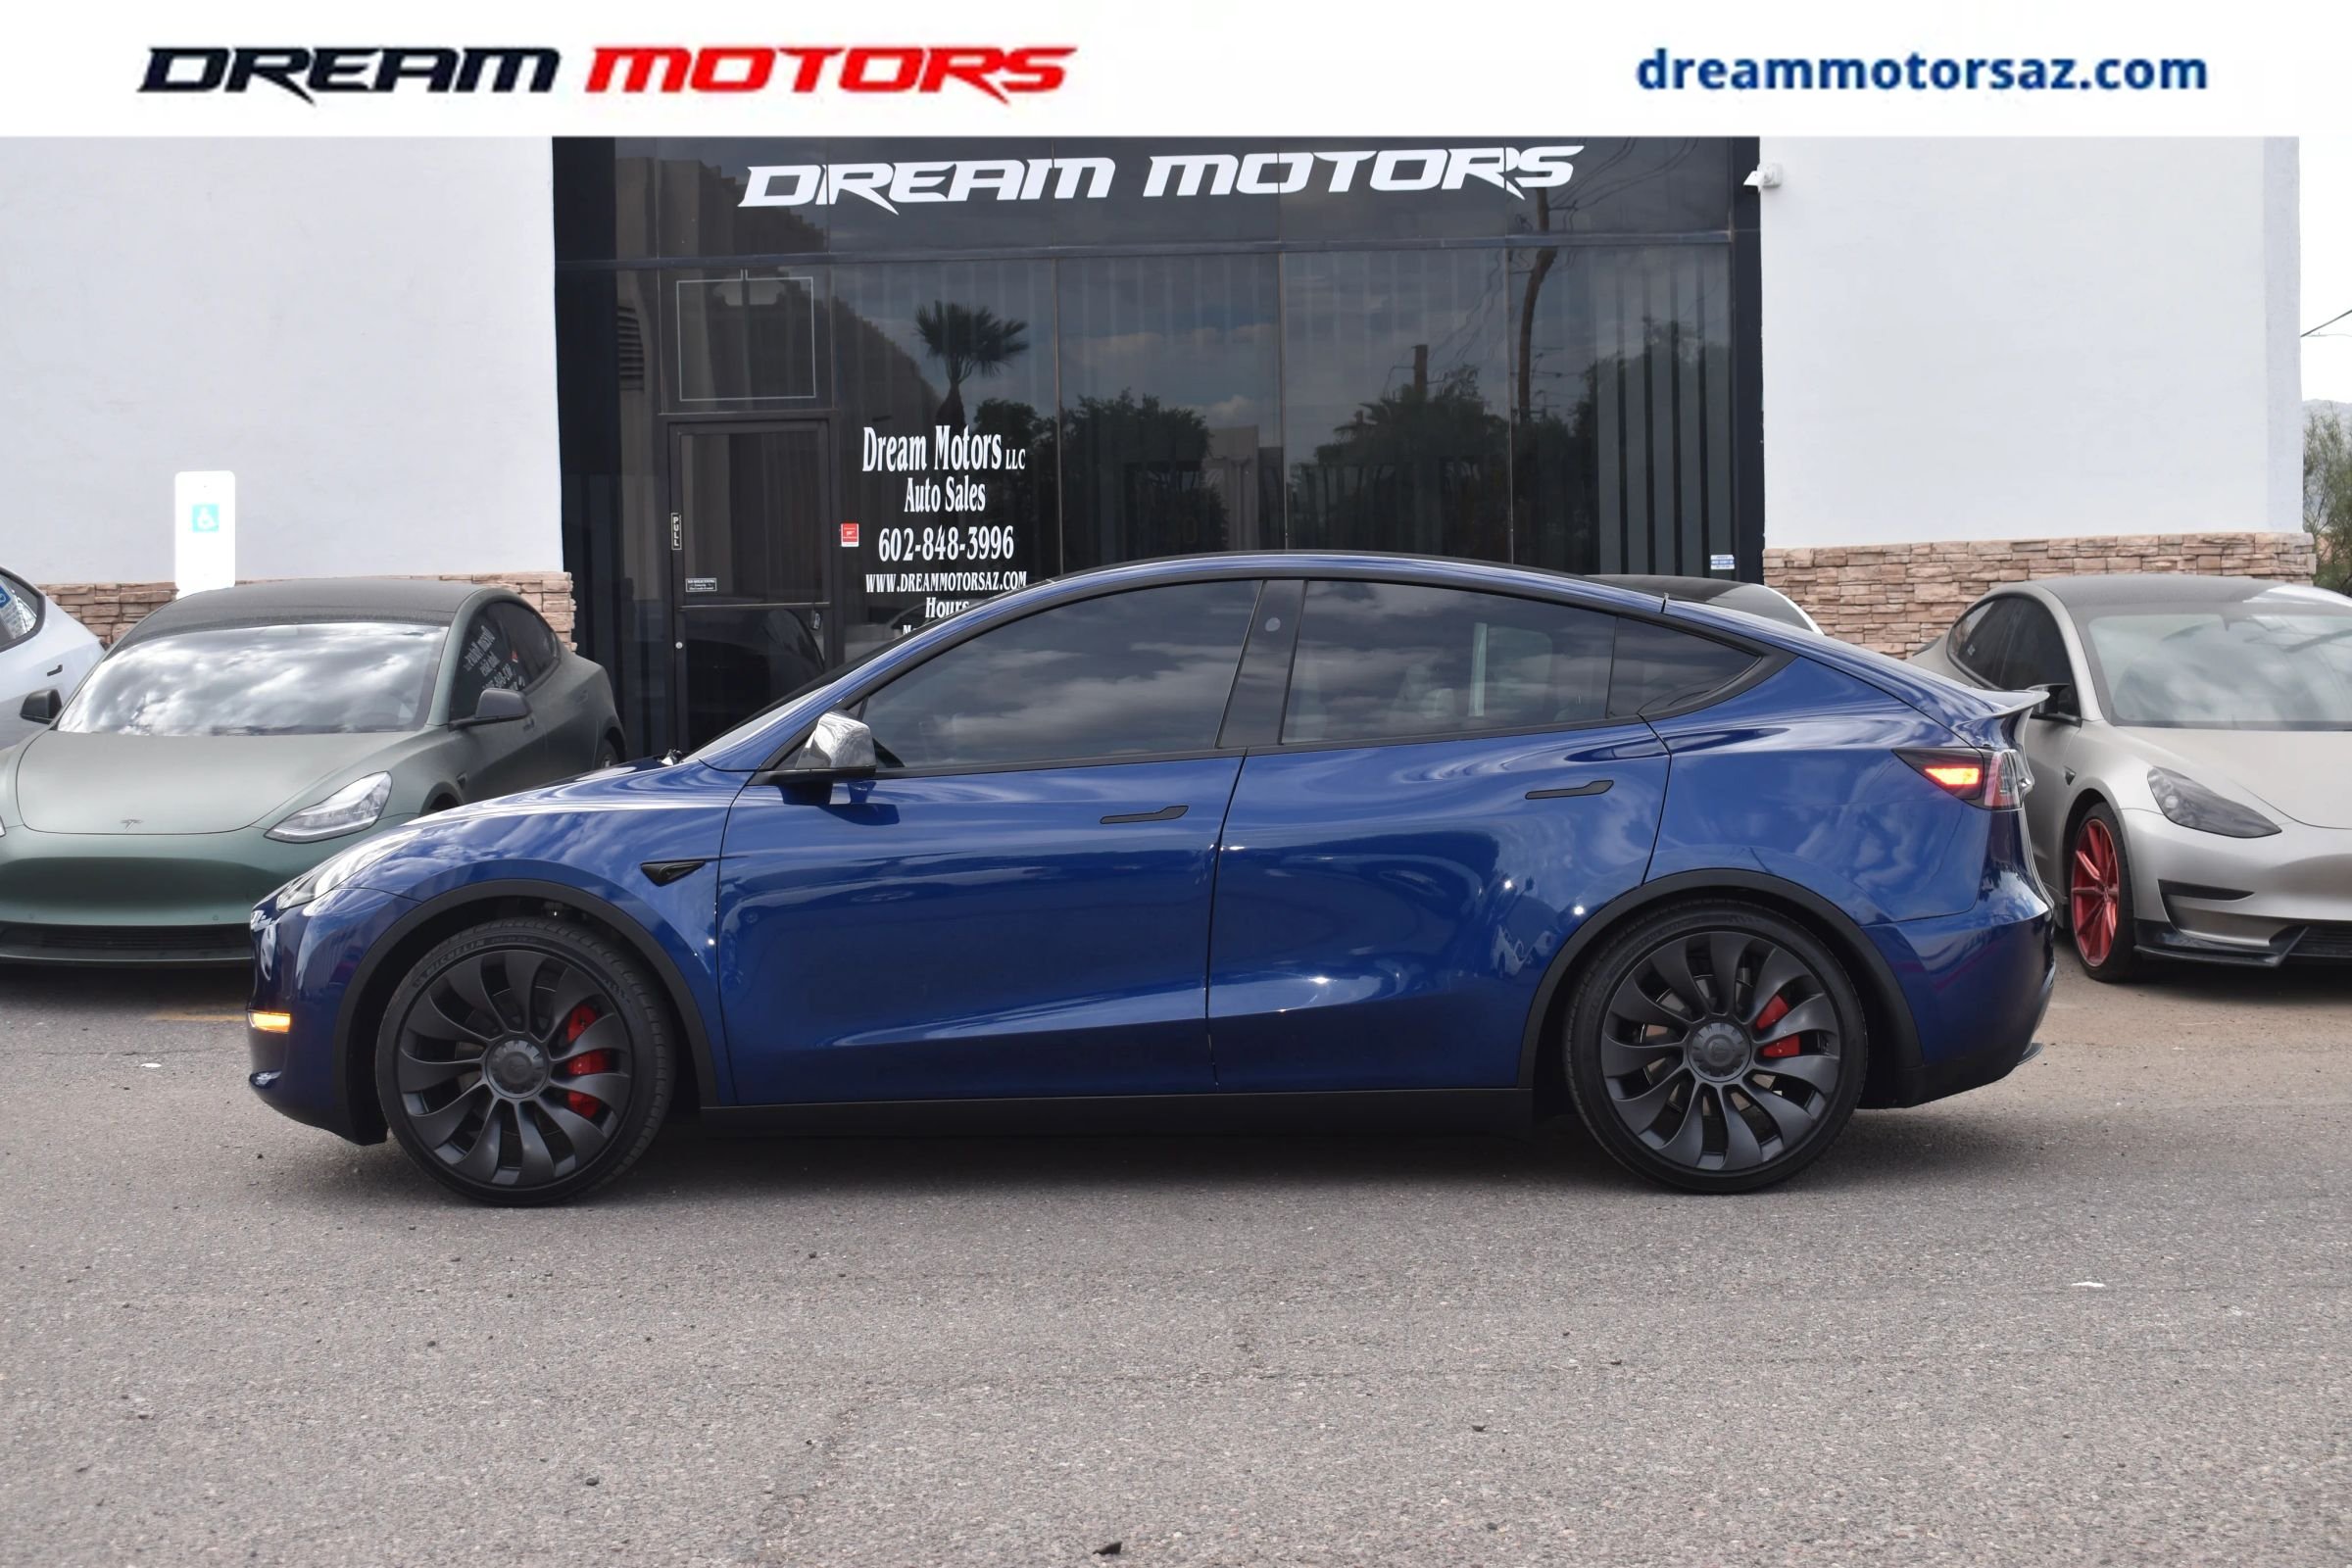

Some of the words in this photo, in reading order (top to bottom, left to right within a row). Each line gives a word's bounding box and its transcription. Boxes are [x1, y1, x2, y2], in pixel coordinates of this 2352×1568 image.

[738, 158, 1115, 215] DREAM
[1143, 146, 1584, 200] MOTORS
[862, 427, 927, 471] Dream
[935, 425, 1002, 470] Motors
[1005, 449, 1025, 469] LLC
[905, 478, 940, 512] Auto
[946, 475, 985, 512] Sales
[879, 525, 1013, 562] 602-848-3996
[866, 571, 1026, 592] WWW.DREAMMOTORSAZ.COM
